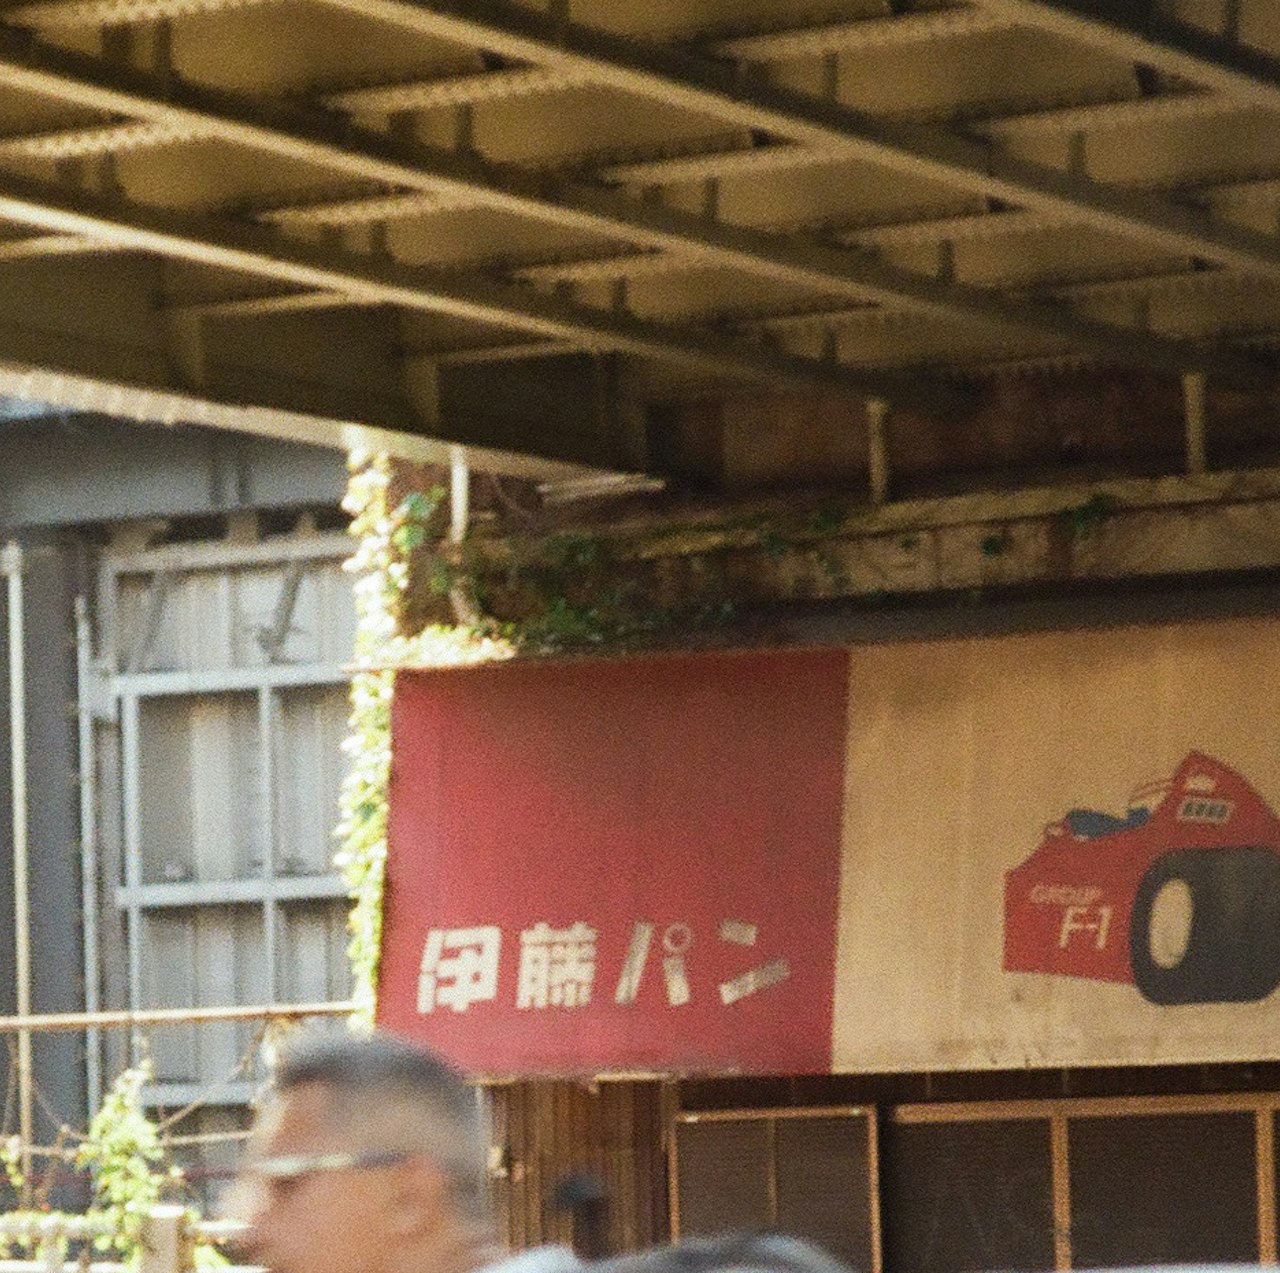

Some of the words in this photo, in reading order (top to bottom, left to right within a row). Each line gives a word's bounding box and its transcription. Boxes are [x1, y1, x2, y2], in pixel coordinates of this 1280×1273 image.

[1058, 904, 1114, 951] F-1
[417, 920, 791, 1014] 伊藤パン
